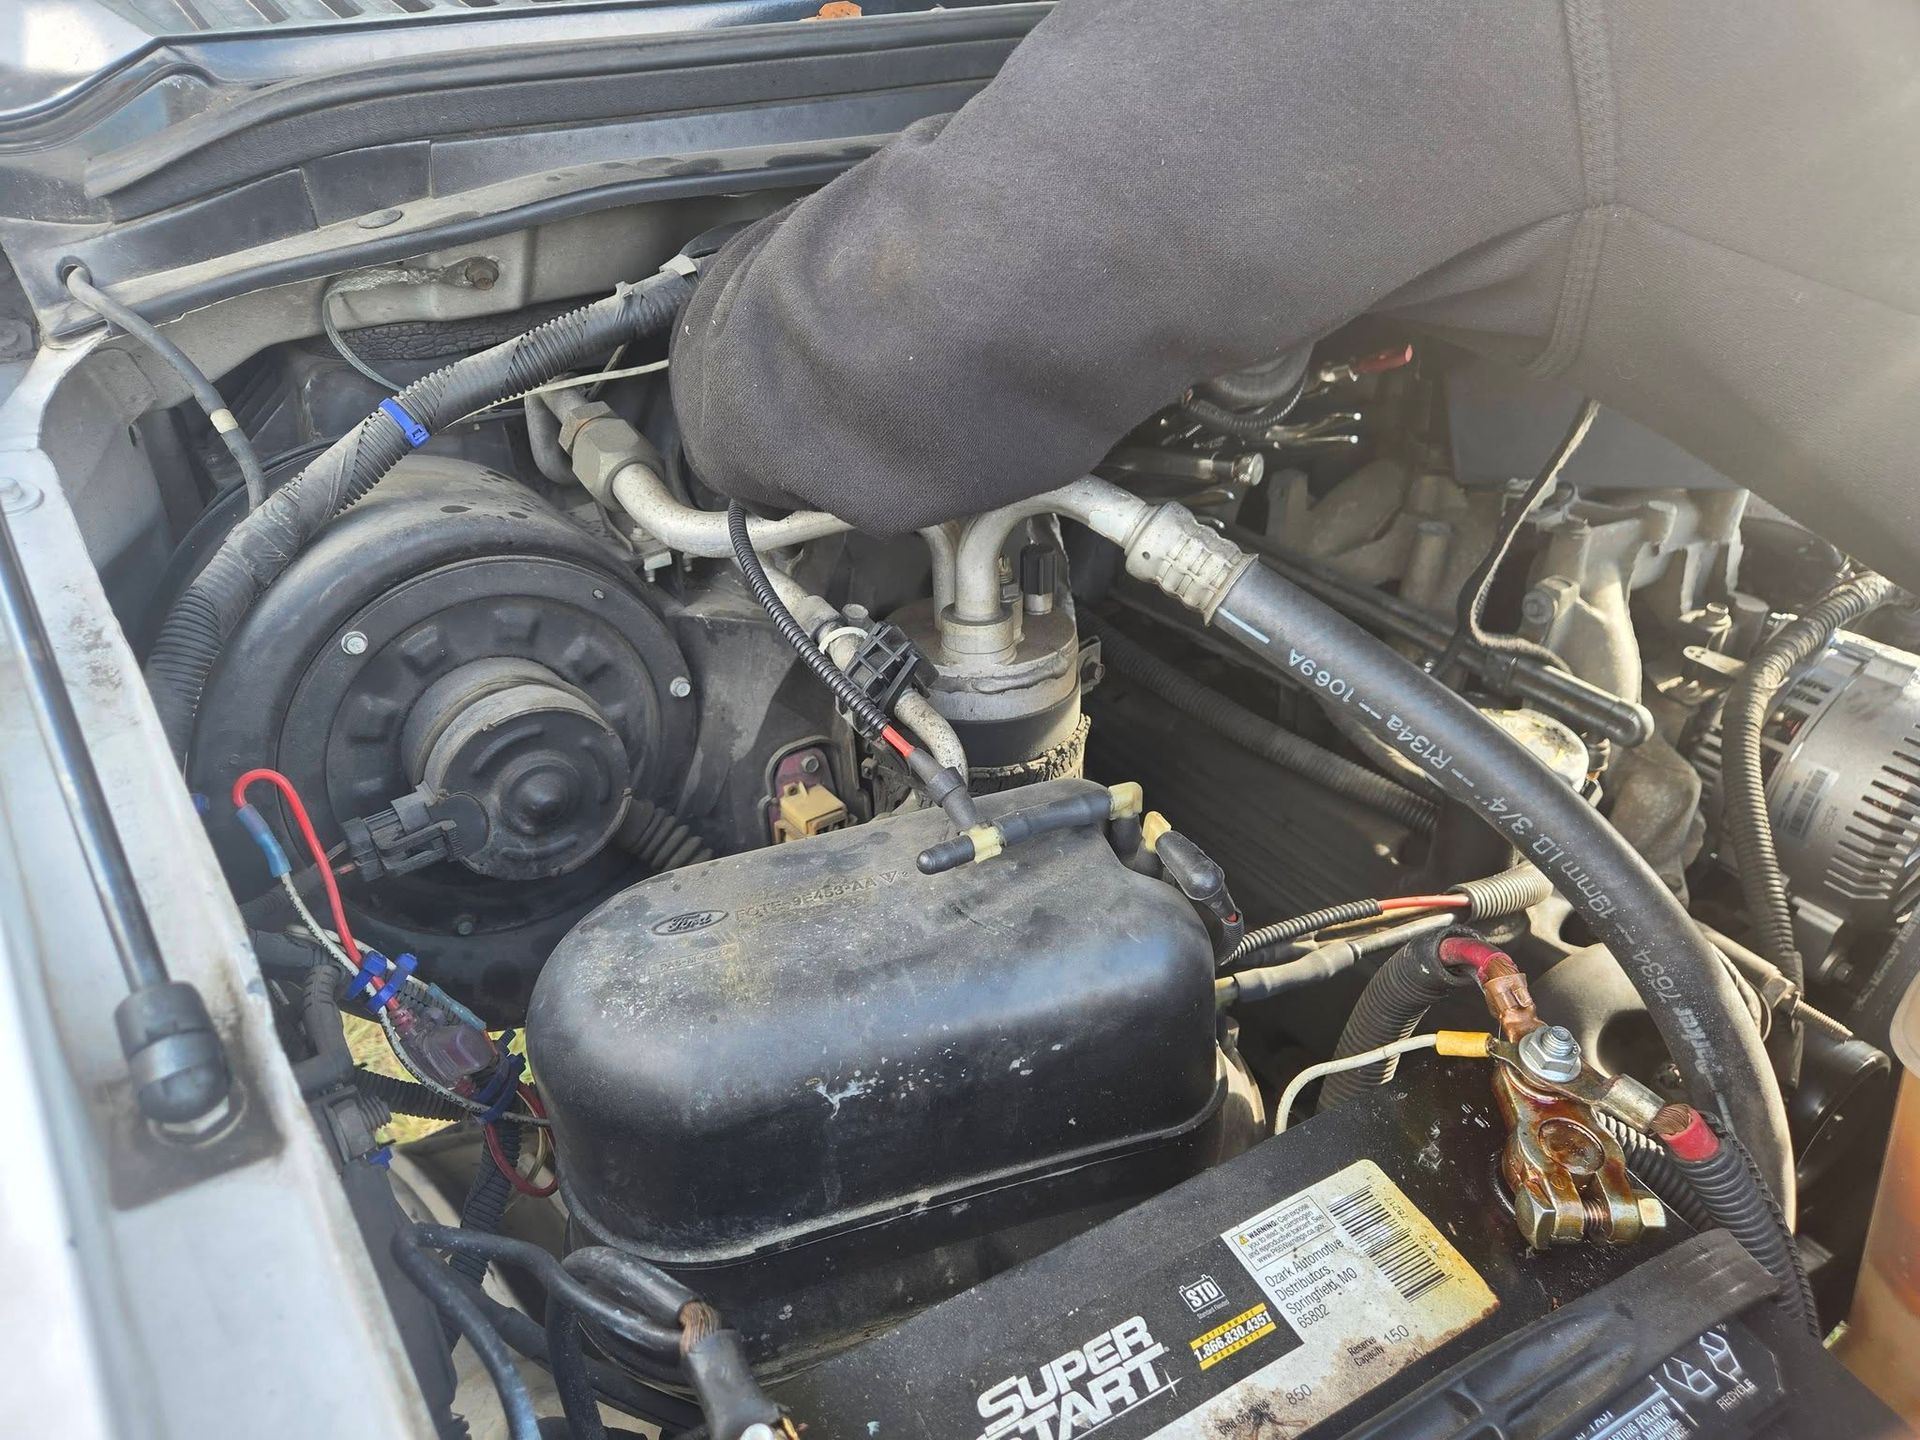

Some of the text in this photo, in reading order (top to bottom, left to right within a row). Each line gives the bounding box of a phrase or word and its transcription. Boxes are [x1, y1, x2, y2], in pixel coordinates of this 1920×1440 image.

[1289, 648, 1355, 702] 1069A
[1386, 714, 1453, 770] R134a
[1560, 861, 1617, 919] 19mm
[1247, 1219, 1278, 1239] WARNING:
[1277, 1211, 1291, 1224] Can
[1248, 1240, 1261, 1251] you
[1248, 1249, 1261, 1259] and
[1264, 1239, 1344, 1288] Ozark Automotive
[1185, 1281, 1219, 1308] STD
[1275, 1265, 1335, 1301] Distributors,
[1286, 1267, 1358, 1315] Springfield, MO
[1200, 1310, 1255, 1342] NATIONWIDE
[1297, 1303, 1331, 1329] 65802
[1194, 1311, 1272, 1361] 1.866.830.4351
[1347, 1335, 1377, 1356] Reserve
[1383, 1324, 1410, 1345] 150
[1353, 1344, 1385, 1367] Capacity
[977, 1316, 1154, 1438] SUPER
[1285, 1383, 1313, 1406] 850
[1716, 1378, 1757, 1411] RECYCLE
[1635, 1400, 1669, 1429] FOLLOW
